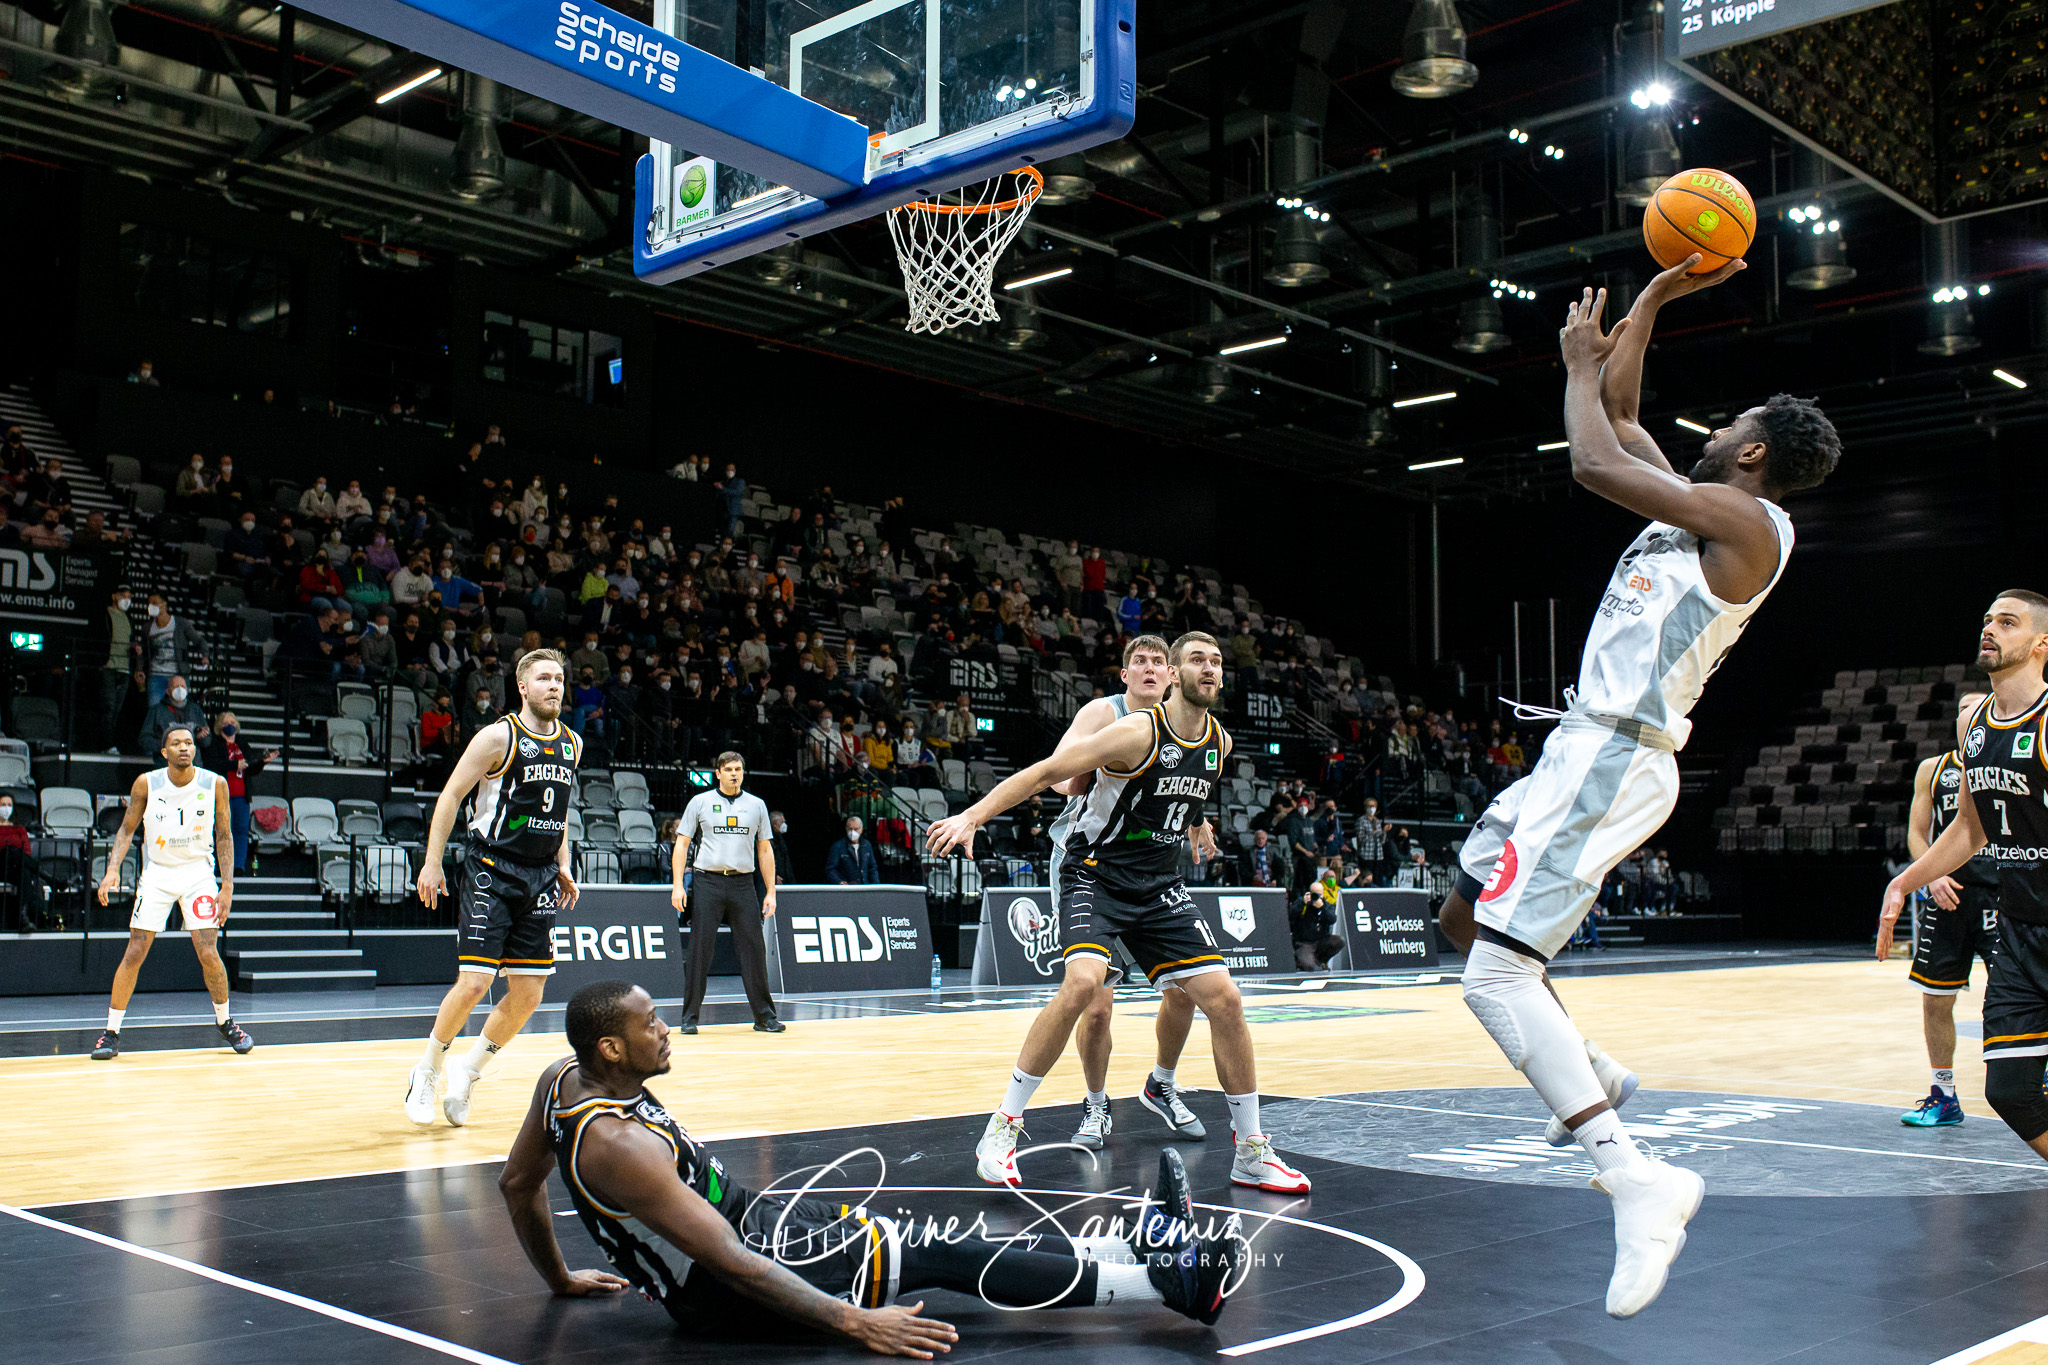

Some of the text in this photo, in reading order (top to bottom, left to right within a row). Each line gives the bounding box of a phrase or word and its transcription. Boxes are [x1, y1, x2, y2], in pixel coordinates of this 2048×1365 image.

[1681, 0, 1775, 35] 25 Köpple
[559, 1, 680, 72] Schelde
[555, 25, 676, 94] Sports
[1691, 174, 1751, 223] Wilson
[676, 208, 710, 227] BARMER
[65, 566, 98, 578] Managed
[65, 576, 94, 588] Services
[523, 764, 573, 787] EAGLES
[1965, 766, 2031, 796] EAGLES
[541, 786, 555, 813] 9
[1153, 776, 1212, 801] EAGLES
[177, 807, 184, 826] 1
[1163, 801, 1190, 832] 13
[1993, 799, 2012, 836] 7
[887, 916, 911, 928] Experts
[1374, 915, 1425, 936] Sparkasse
[791, 916, 884, 963] EMS
[888, 928, 918, 940] Managed
[889, 939, 917, 950] Services
[1379, 937, 1427, 958] Nürnberg
[1245, 955, 1269, 968] EVENTS
